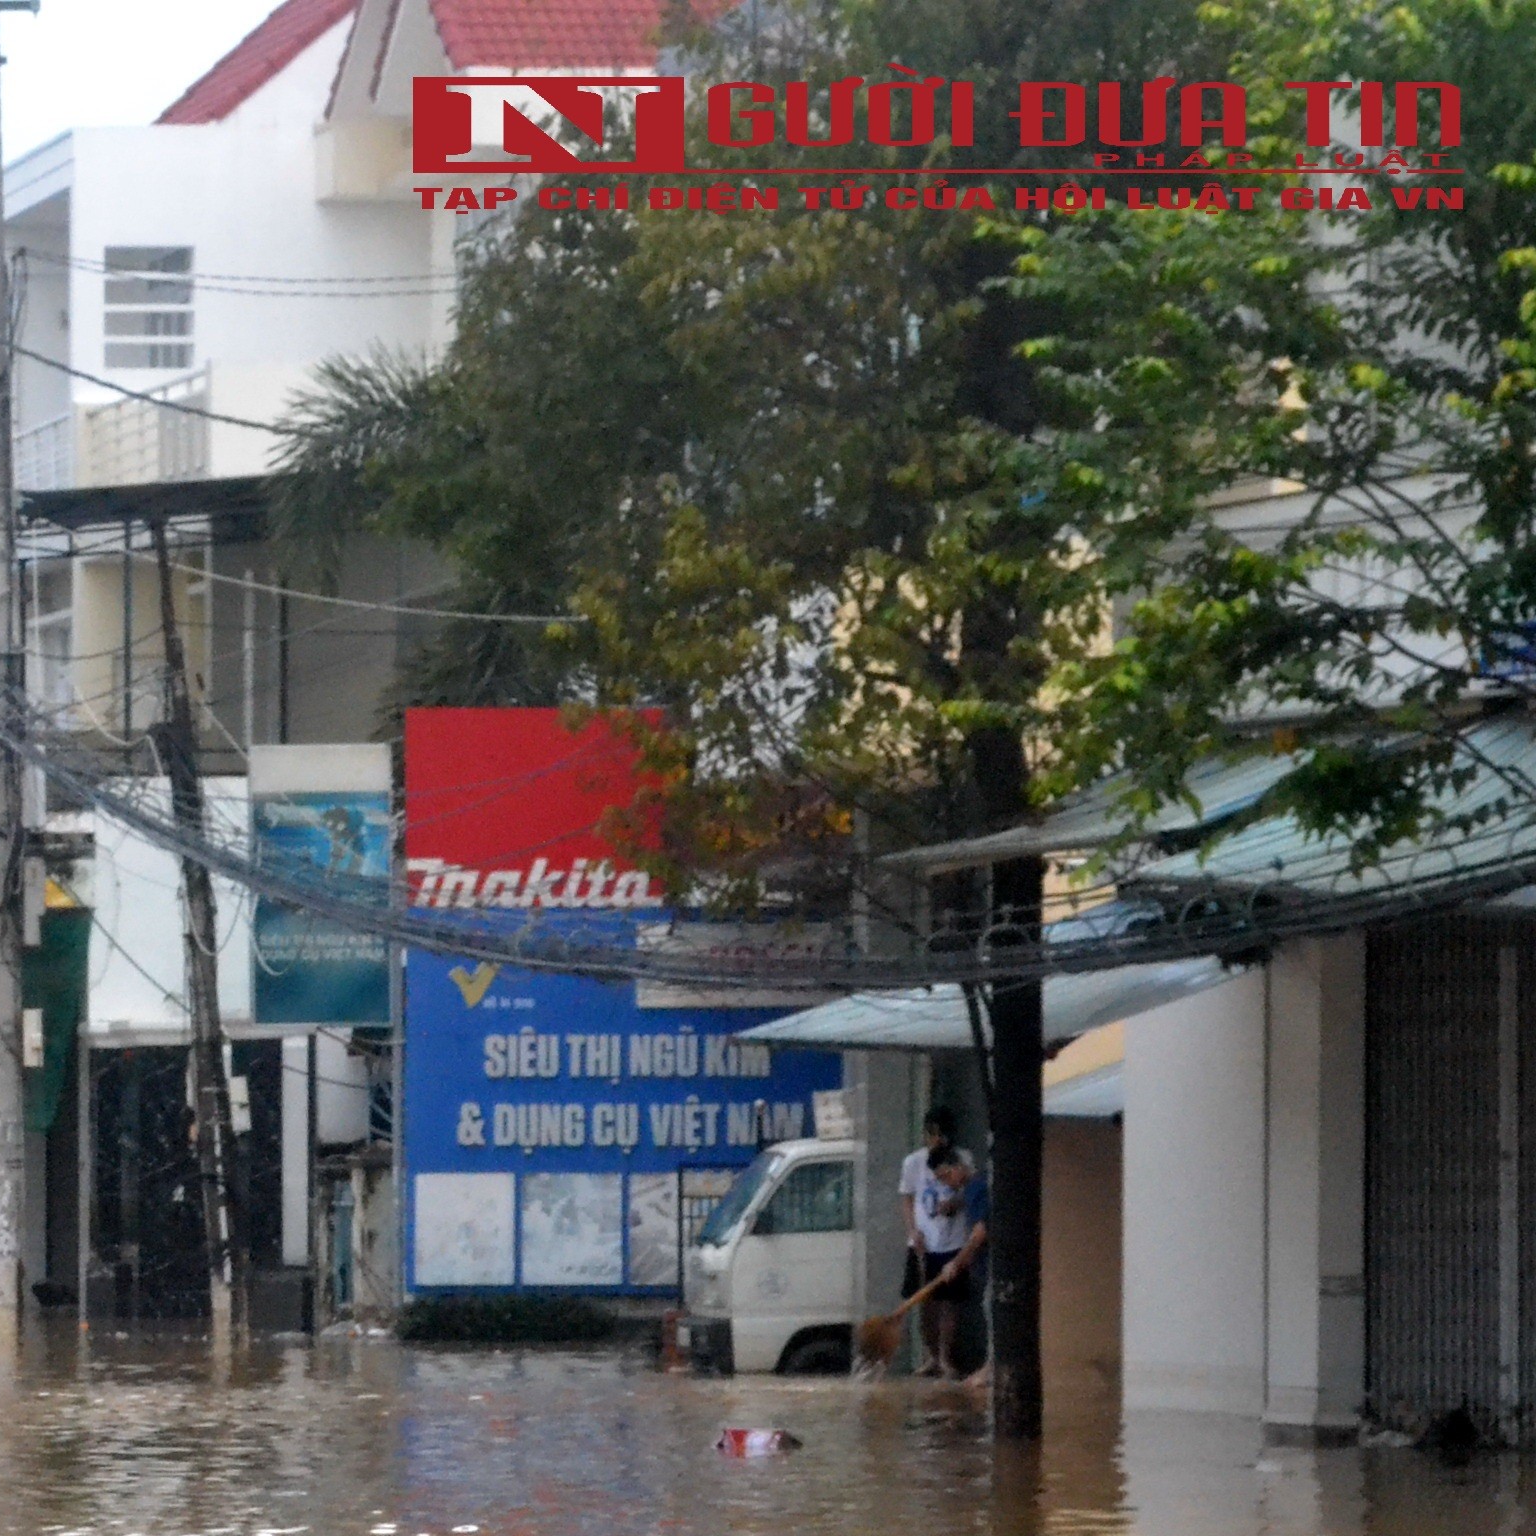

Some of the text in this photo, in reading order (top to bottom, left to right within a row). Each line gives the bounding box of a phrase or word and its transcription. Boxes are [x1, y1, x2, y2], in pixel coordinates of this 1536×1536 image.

[484, 1025, 772, 1085] SIÊU THỊ NGŨ KIM
[457, 1094, 805, 1154] & DỤNG CỤ VIỆT NAM
